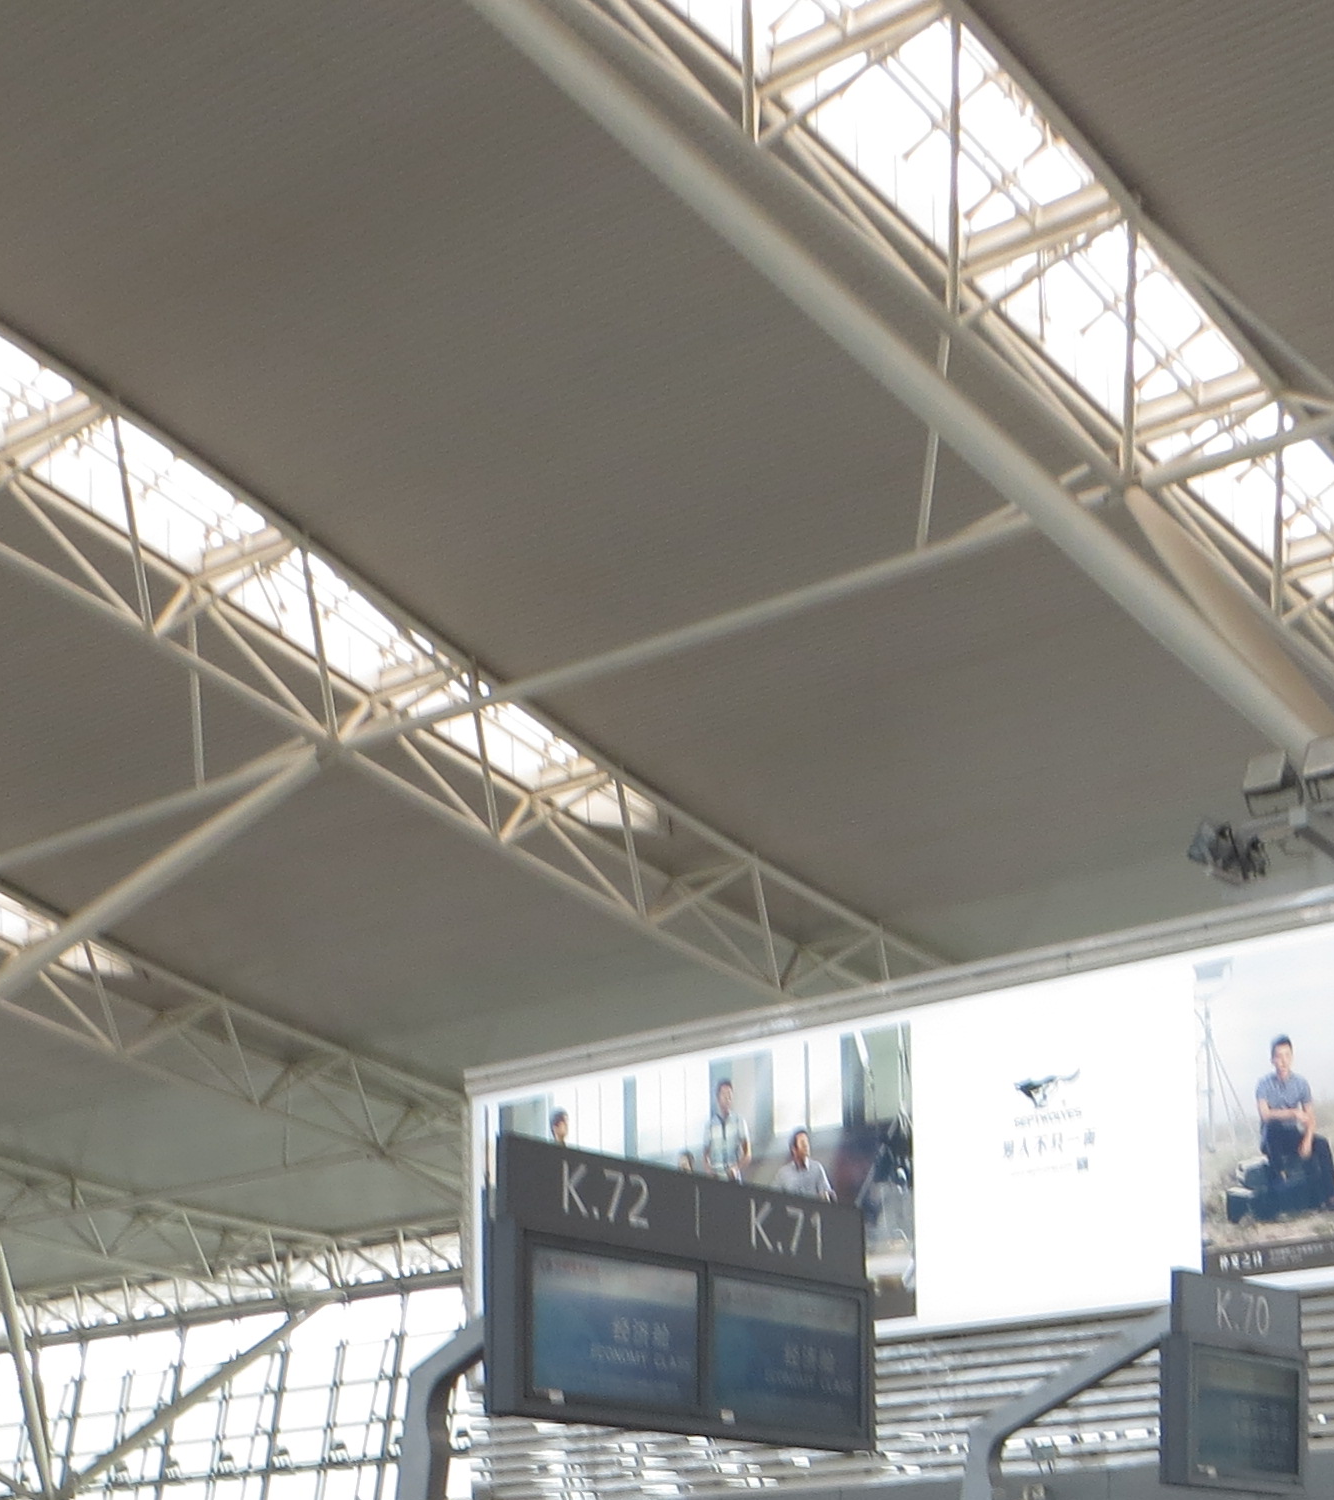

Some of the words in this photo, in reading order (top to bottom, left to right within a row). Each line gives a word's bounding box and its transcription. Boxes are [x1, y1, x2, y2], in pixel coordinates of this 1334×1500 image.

[560, 1159, 651, 1230] K.72
[749, 1197, 824, 1260] K.71
[1217, 1286, 1270, 1337] K.70
